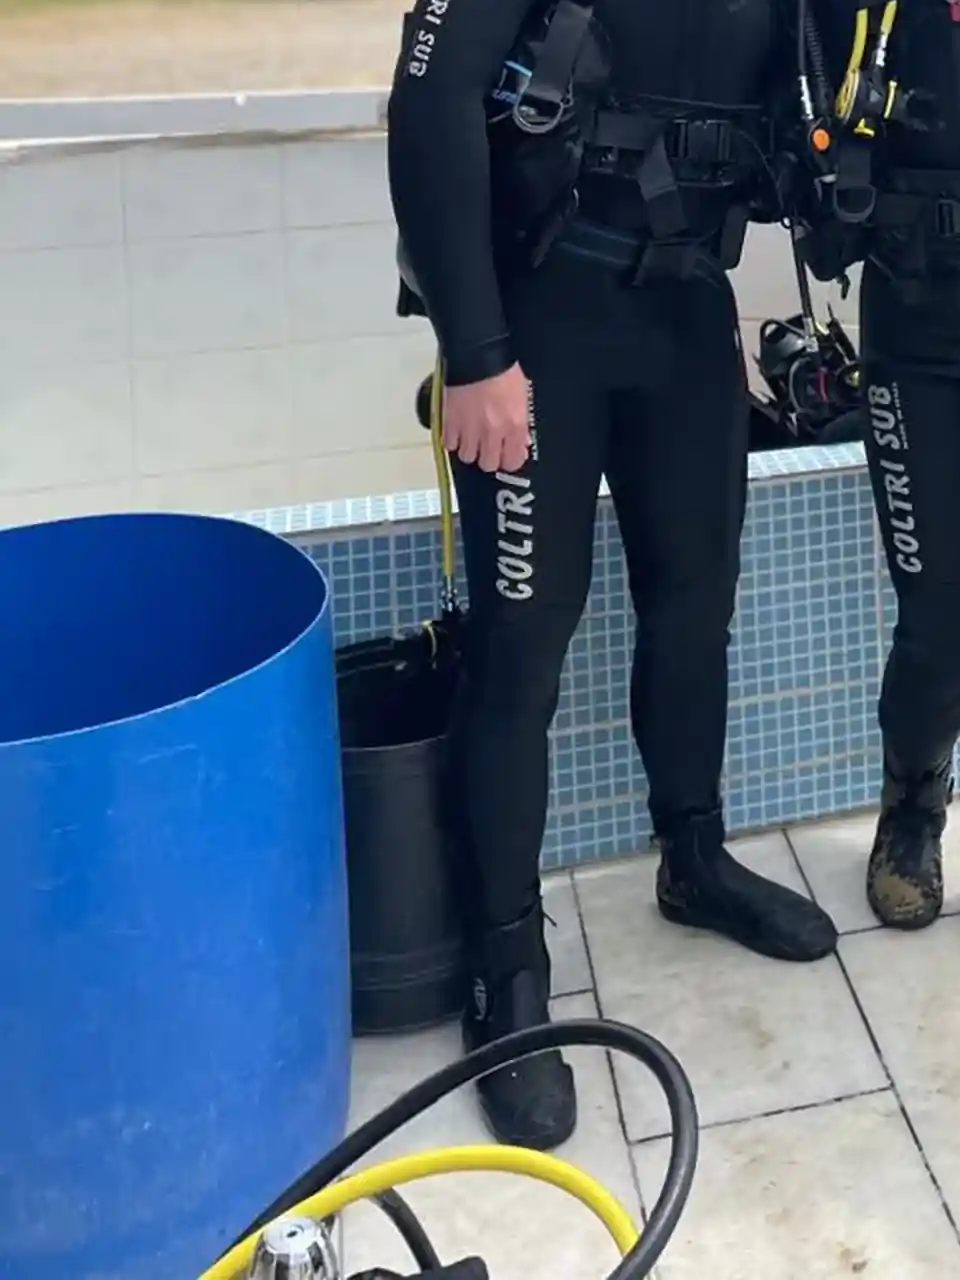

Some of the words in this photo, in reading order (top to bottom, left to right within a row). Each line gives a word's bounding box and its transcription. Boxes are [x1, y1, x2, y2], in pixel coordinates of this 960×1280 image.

[408, 29, 436, 78] SUB
[867, 384, 901, 451] SUB
[495, 471, 536, 601] COLTRI
[879, 459, 923, 574] COLTRI
